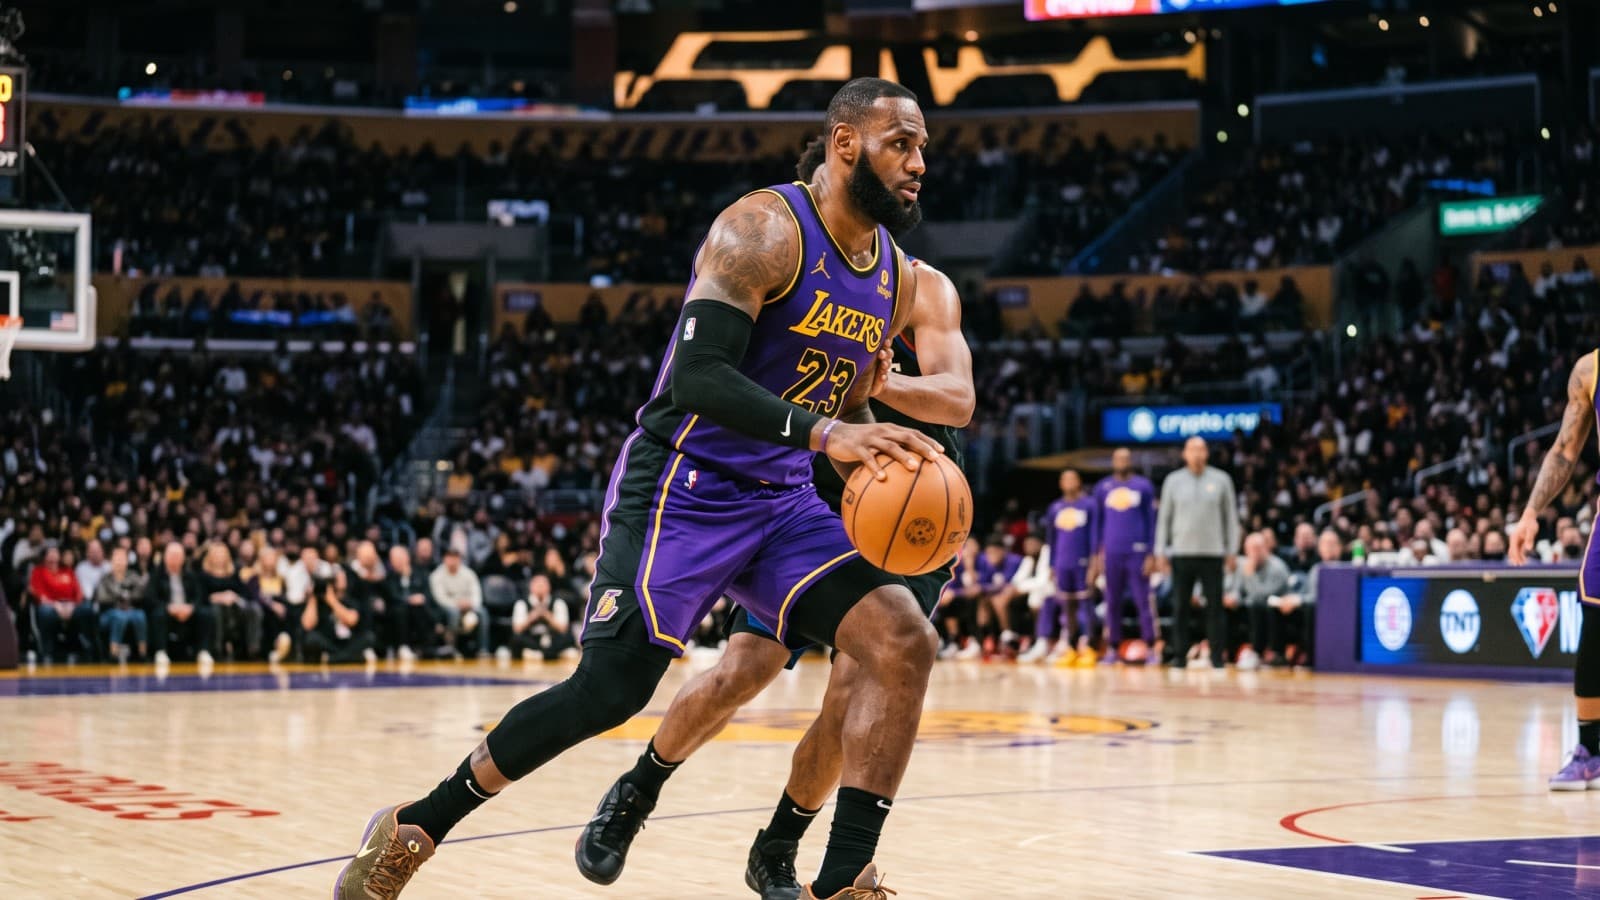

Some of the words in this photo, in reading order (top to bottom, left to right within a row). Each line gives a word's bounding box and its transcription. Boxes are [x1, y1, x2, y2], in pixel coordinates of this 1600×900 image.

[788, 289, 885, 353] LAKERS
[781, 347, 857, 420] 23
[1440, 611, 1481, 632] TNT
